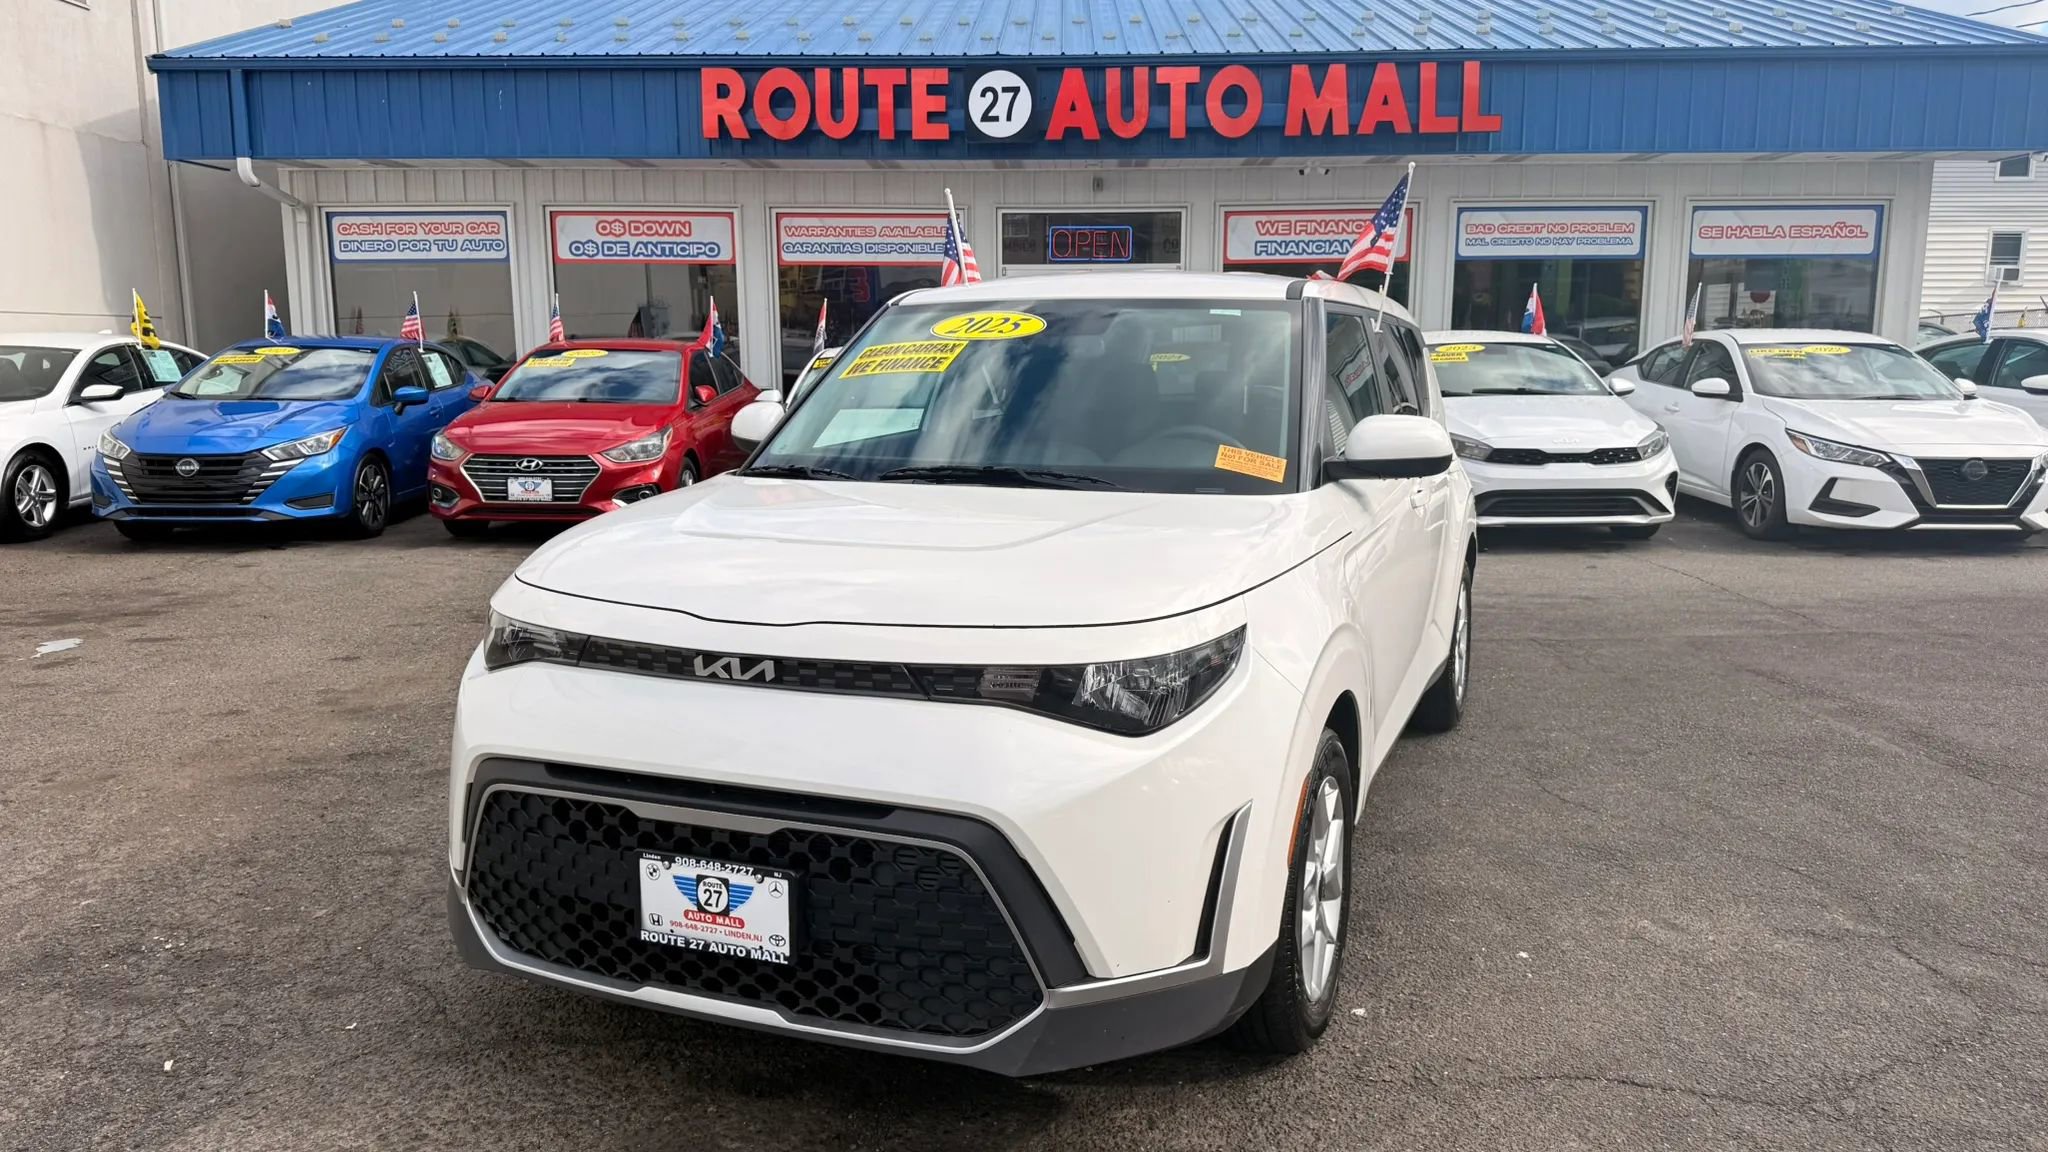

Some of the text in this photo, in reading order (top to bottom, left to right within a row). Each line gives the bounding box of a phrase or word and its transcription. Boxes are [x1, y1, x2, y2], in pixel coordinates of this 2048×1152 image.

[701, 60, 1502, 141] ROUTE 27 AUTO MALL
[338, 222, 500, 235] CASH FOR YOUR CAR
[628, 221, 691, 237] DOWN
[784, 226, 876, 238] WARRANTIES
[1256, 220, 1371, 236] WE FINANC
[1466, 223, 1635, 234] BAD CREDIT NO PROBLEM
[1699, 221, 1868, 239] SE HABLA ESPAÑOL
[340, 239, 505, 252] DINERO POR TU AUTO
[601, 241, 630, 256] DE
[631, 241, 721, 257] ANTICIPO
[783, 242, 946, 254] GARANTIAS DISPONIBLE
[1052, 229, 1130, 258] OPEN
[1465, 236, 1633, 247] MAL CREDITO NO HAY PROBLEMA
[944, 316, 1032, 335] 2025
[860, 342, 964, 360] CLEAN CARFAX
[846, 360, 873, 375] WE
[872, 356, 949, 372] FINANCE
[1237, 455, 1257, 464] FOR
[1260, 460, 1281, 470] SALE
[1244, 451, 1283, 464] VEHICLE
[643, 852, 661, 860] Linden
[674, 856, 754, 876] 908-648-2727
[702, 881, 723, 889] ROUTE
[703, 888, 723, 908] 27
[669, 919, 718, 935] 908-648-2727
[687, 911, 742, 928] AUTO MALL
[640, 929, 789, 965] ROUTE 27 AUTO MALL
